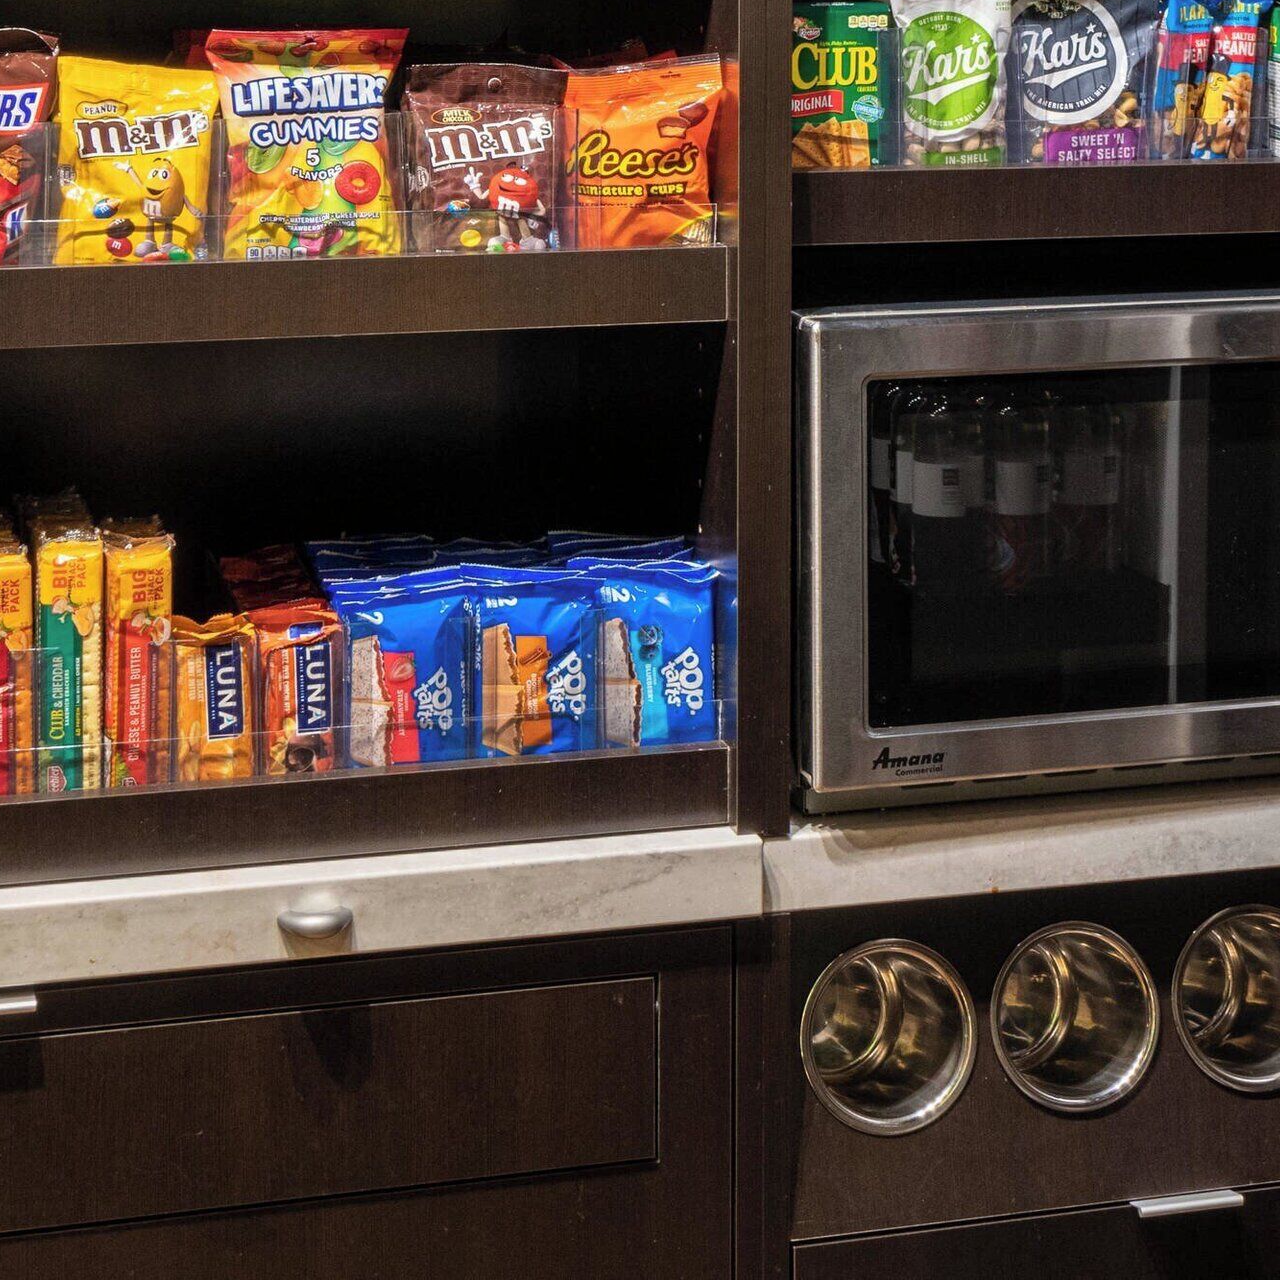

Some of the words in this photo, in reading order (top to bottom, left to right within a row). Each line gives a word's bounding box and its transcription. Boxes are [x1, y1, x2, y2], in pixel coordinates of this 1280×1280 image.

[791, 43, 877, 90] CLUB
[84, 105, 117, 115] PEANUT
[252, 116, 377, 147] GUMMIES
[1072, 136, 1105, 147] SWEET
[306, 150, 320, 165] 5
[569, 131, 698, 176] Reese's
[945, 154, 988, 165] IN-SHELL
[1059, 150, 1095, 161] SALTY
[1098, 147, 1136, 159] SELECT
[291, 163, 344, 181] FLAVORS
[650, 183, 684, 195] cups
[10, 579, 19, 612] PACK
[216, 649, 238, 730] LUNA
[305, 645, 326, 724] LUNA
[50, 710, 65, 740] CLUB
[873, 747, 944, 769] Amana
[896, 765, 943, 776] Commercial
